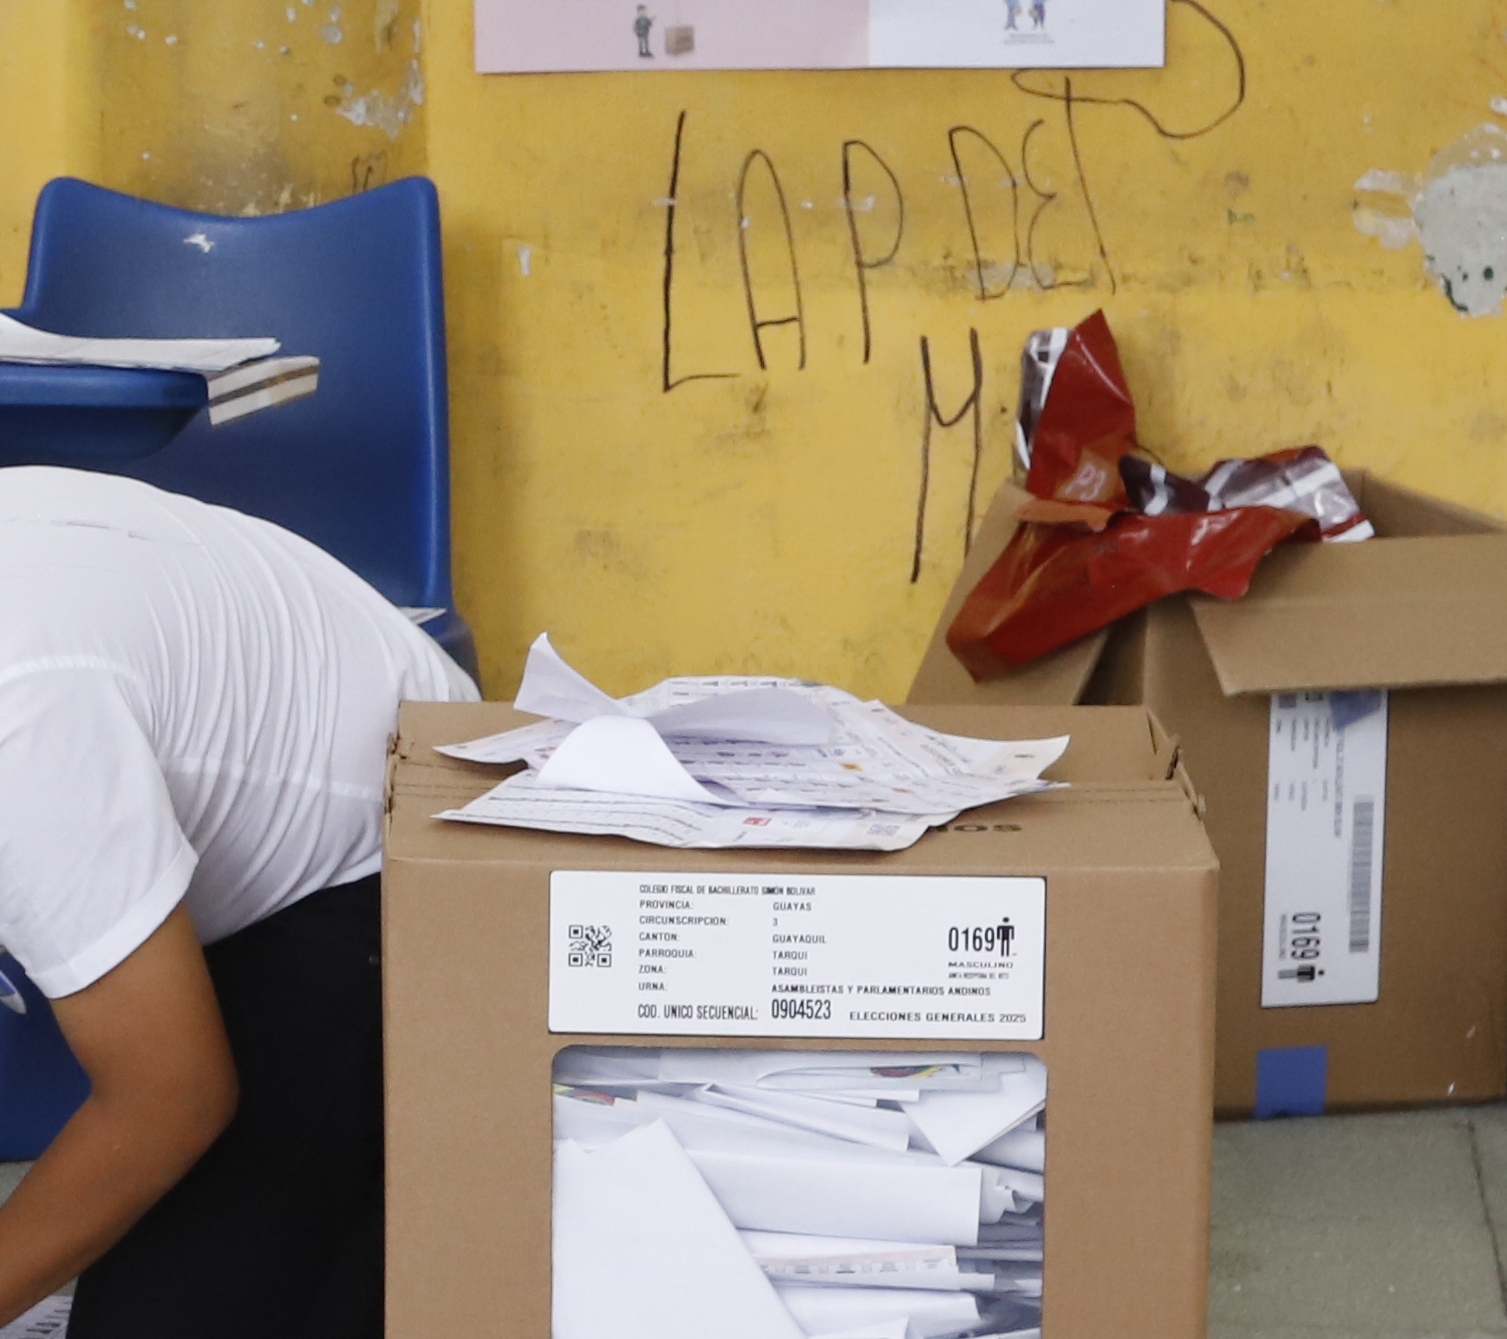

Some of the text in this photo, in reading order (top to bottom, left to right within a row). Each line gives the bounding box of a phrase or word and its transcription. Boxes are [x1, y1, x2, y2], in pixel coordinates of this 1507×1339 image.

[639, 884, 669, 894] COLEGIO
[670, 884, 694, 894] FISCAL
[696, 885, 706, 895] DE
[708, 885, 759, 895] BACHILLERATO
[639, 899, 812, 912] PROVINCIA: GUAYAS
[772, 917, 778, 927] 3
[772, 934, 827, 944] GUAYAQUIL
[947, 926, 996, 953] 0169
[1290, 912, 1321, 961] 0169
[638, 948, 808, 961] PARROQUIA: TARQUI
[638, 964, 808, 977] ZONA: TARQUI
[638, 981, 668, 992] URNA:
[847, 985, 854, 995] Y
[856, 985, 944, 996] PARLAMENTARIOS
[947, 986, 991, 996] ANDINOS
[637, 1003, 660, 1019] COD.
[696, 1004, 759, 1020] SECUENCIAL:
[771, 999, 831, 1020] 0904523
[849, 1010, 1027, 1023] ELECCIONES GENERALES 2025
